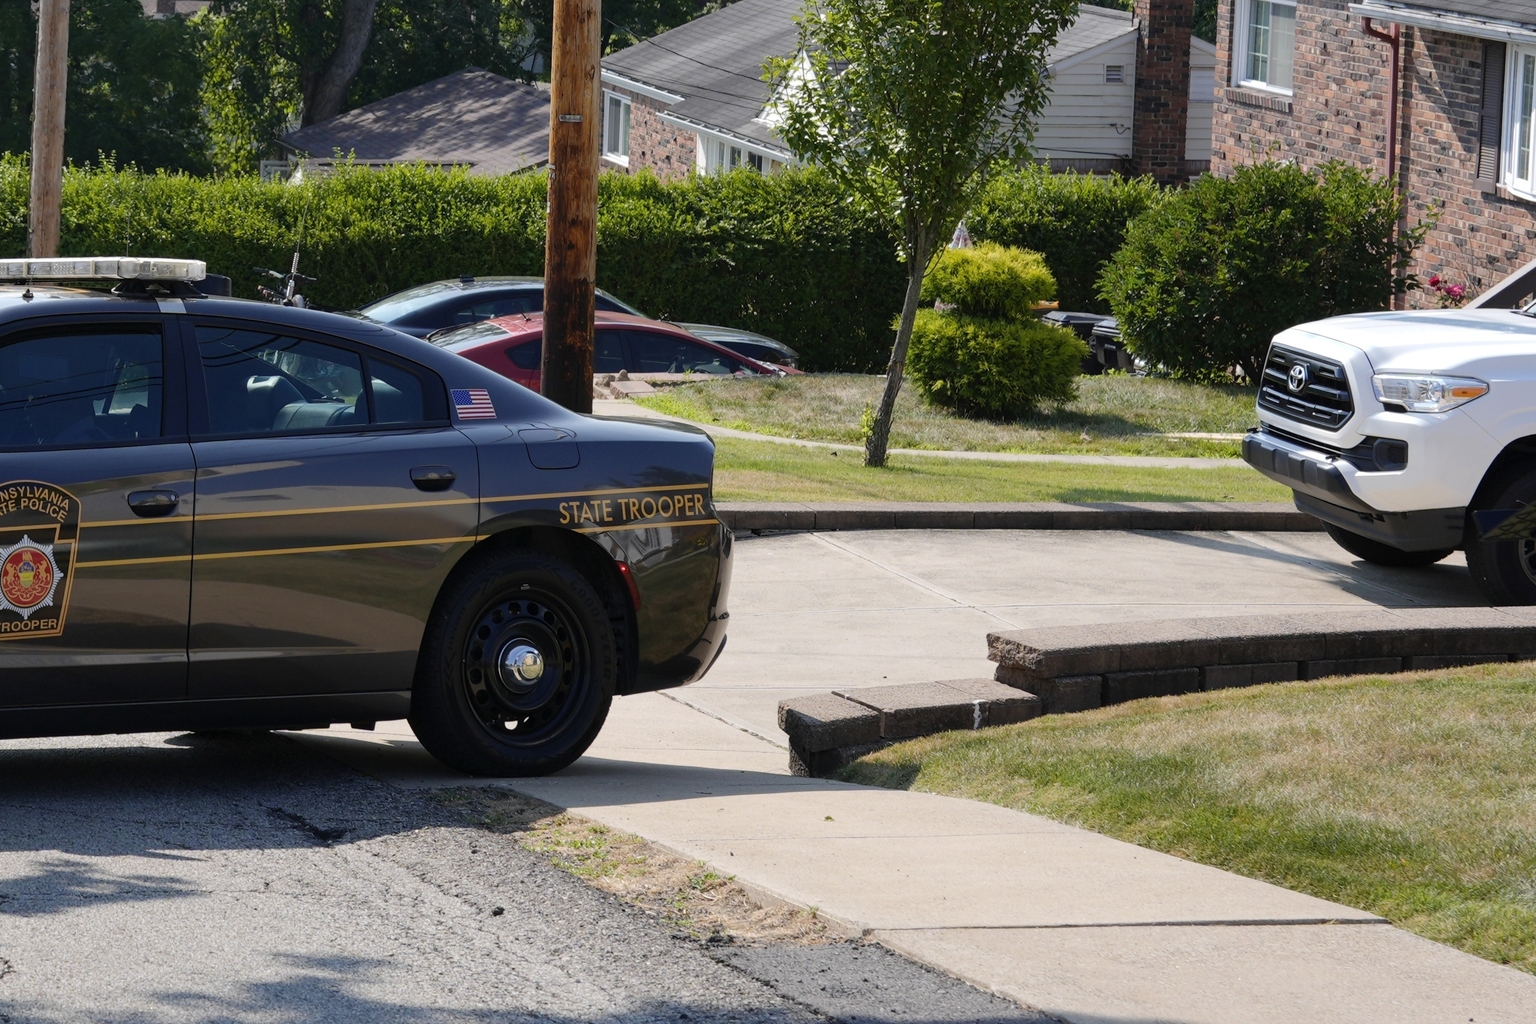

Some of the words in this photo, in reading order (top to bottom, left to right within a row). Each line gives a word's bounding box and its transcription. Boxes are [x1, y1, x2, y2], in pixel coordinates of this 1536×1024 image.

[20, 498, 68, 523] POLICE
[558, 498, 613, 524] STATE
[617, 493, 706, 521] TROOPER
